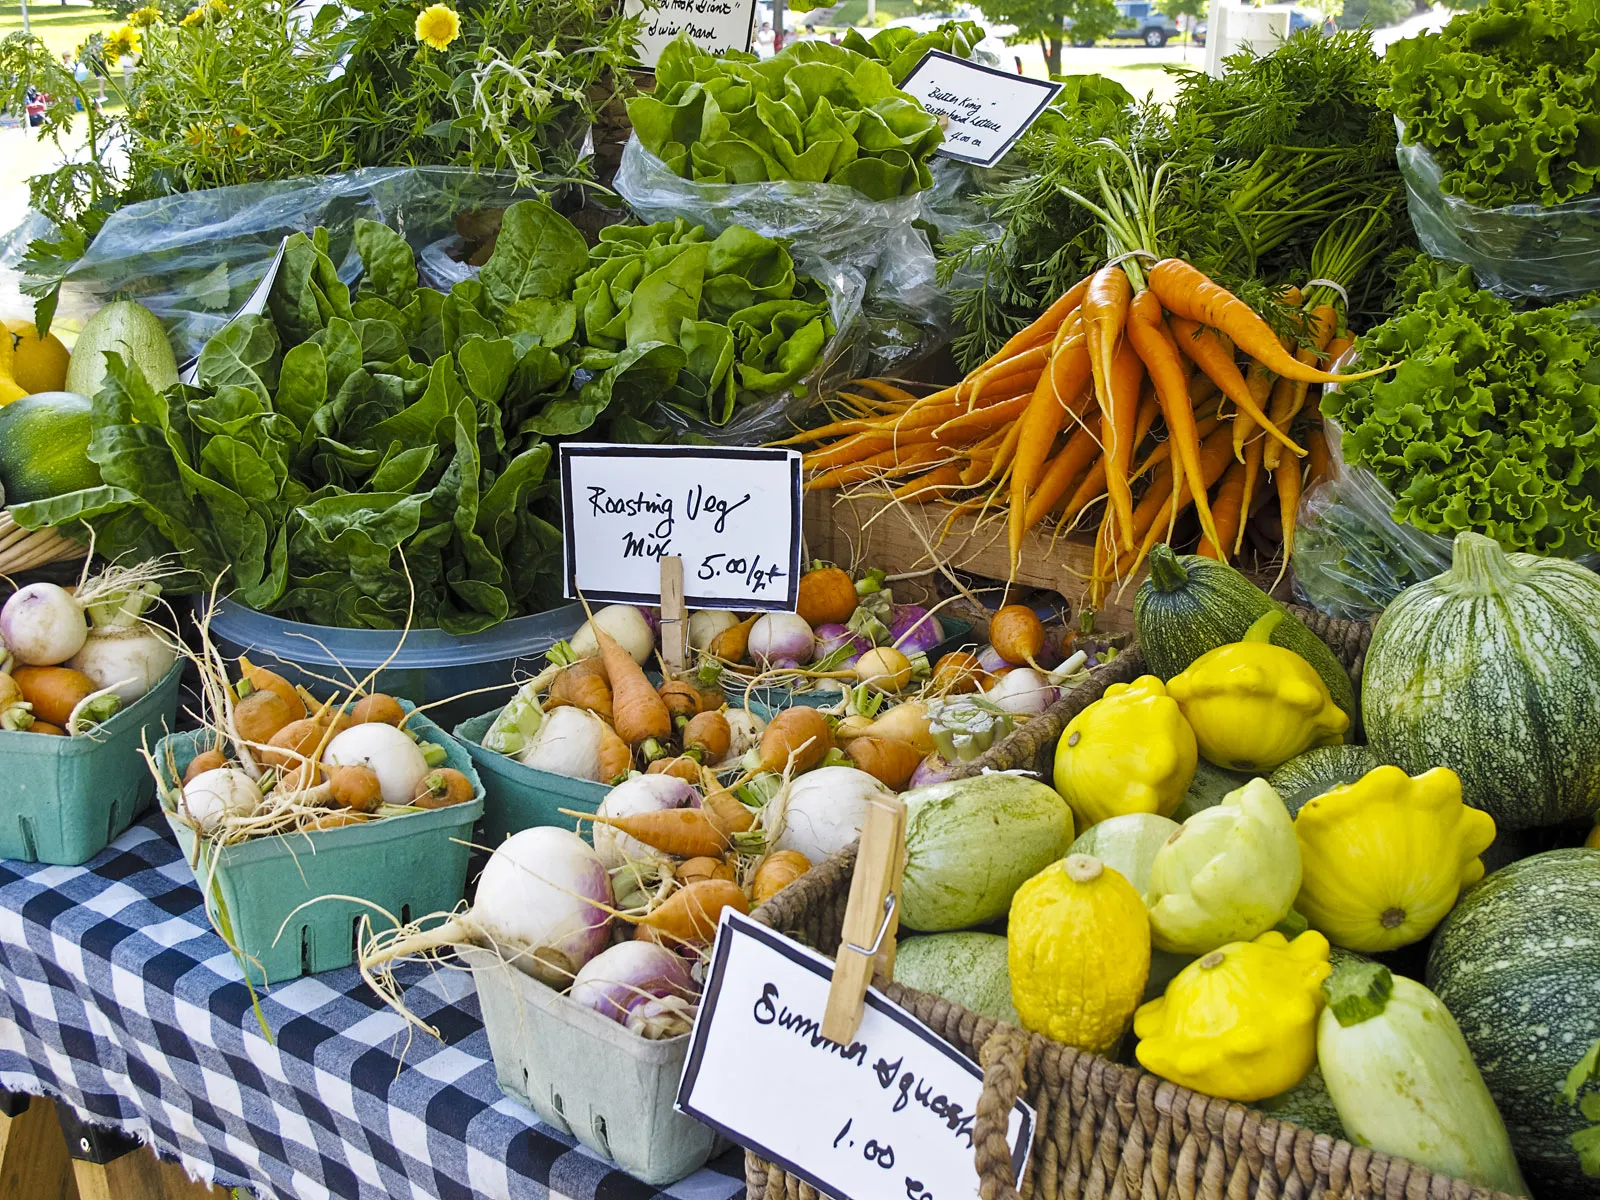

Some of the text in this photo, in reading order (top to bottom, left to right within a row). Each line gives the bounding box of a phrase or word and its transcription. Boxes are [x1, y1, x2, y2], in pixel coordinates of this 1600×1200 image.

[648, 17, 681, 37] Swis
[586, 484, 751, 539] Roasting Veg
[753, 982, 869, 1067] Summer
[832, 1117, 896, 1170] 1.00
